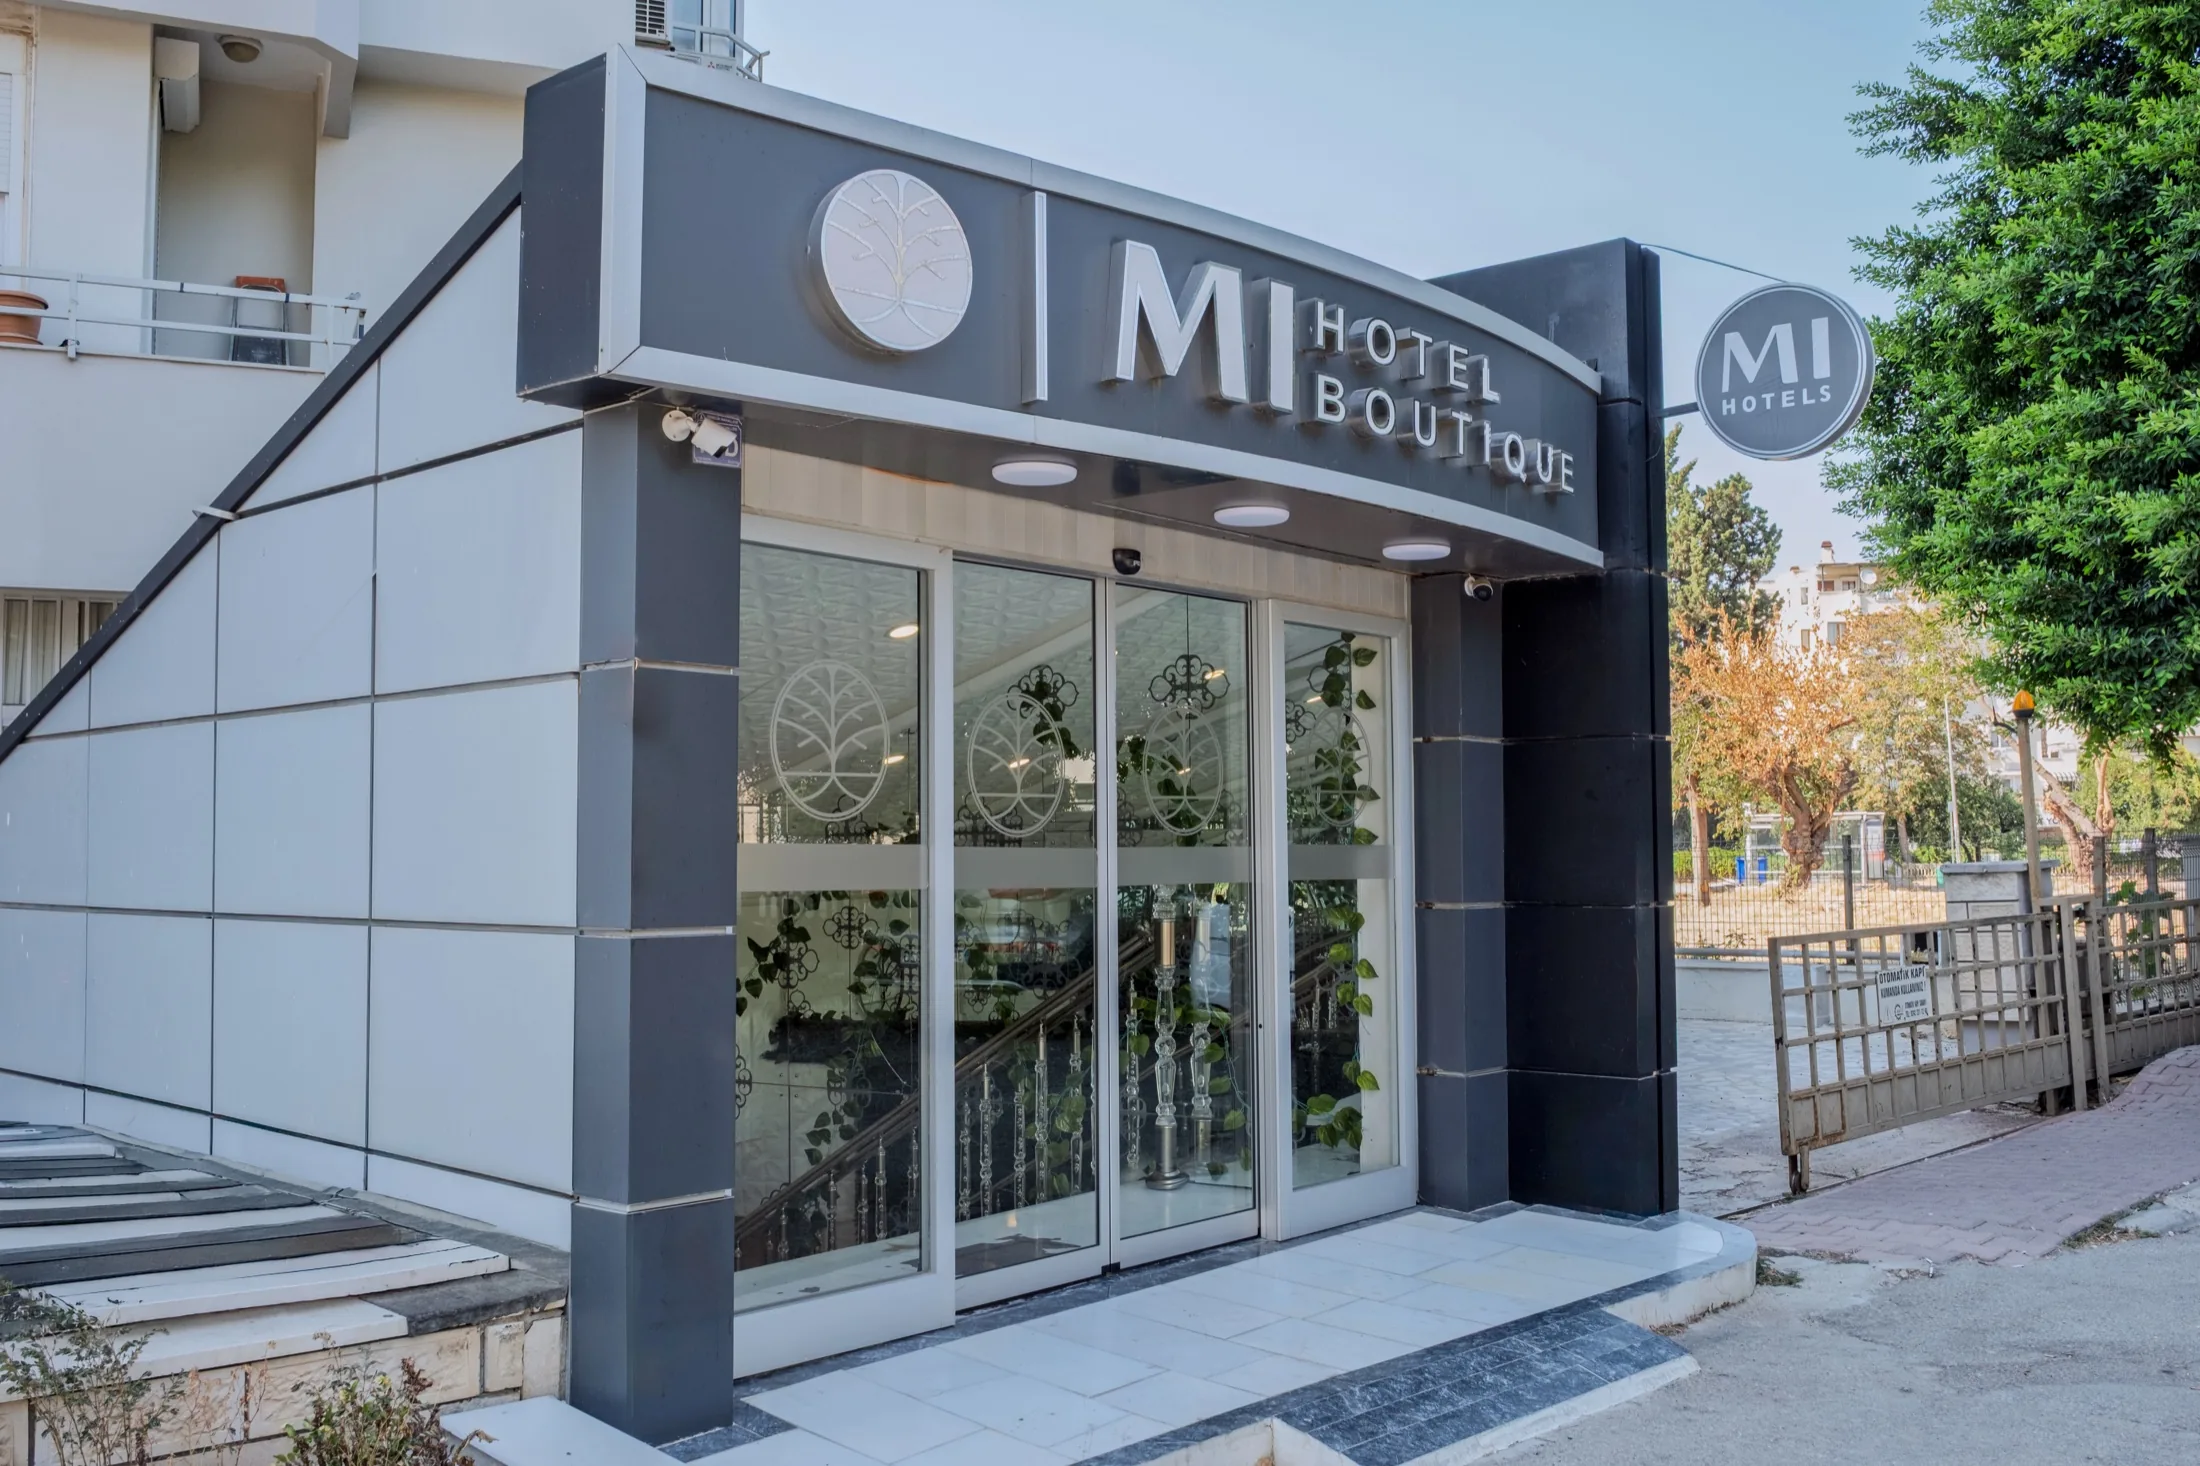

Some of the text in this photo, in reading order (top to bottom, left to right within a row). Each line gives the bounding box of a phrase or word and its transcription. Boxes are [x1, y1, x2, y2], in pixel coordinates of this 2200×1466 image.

[1110, 239, 1296, 415] MI
[1309, 297, 1501, 405] HOTEL
[1721, 316, 1831, 394] MI
[1310, 370, 1576, 495] BOUTIQUE
[1721, 384, 1832, 417] HOTELS
